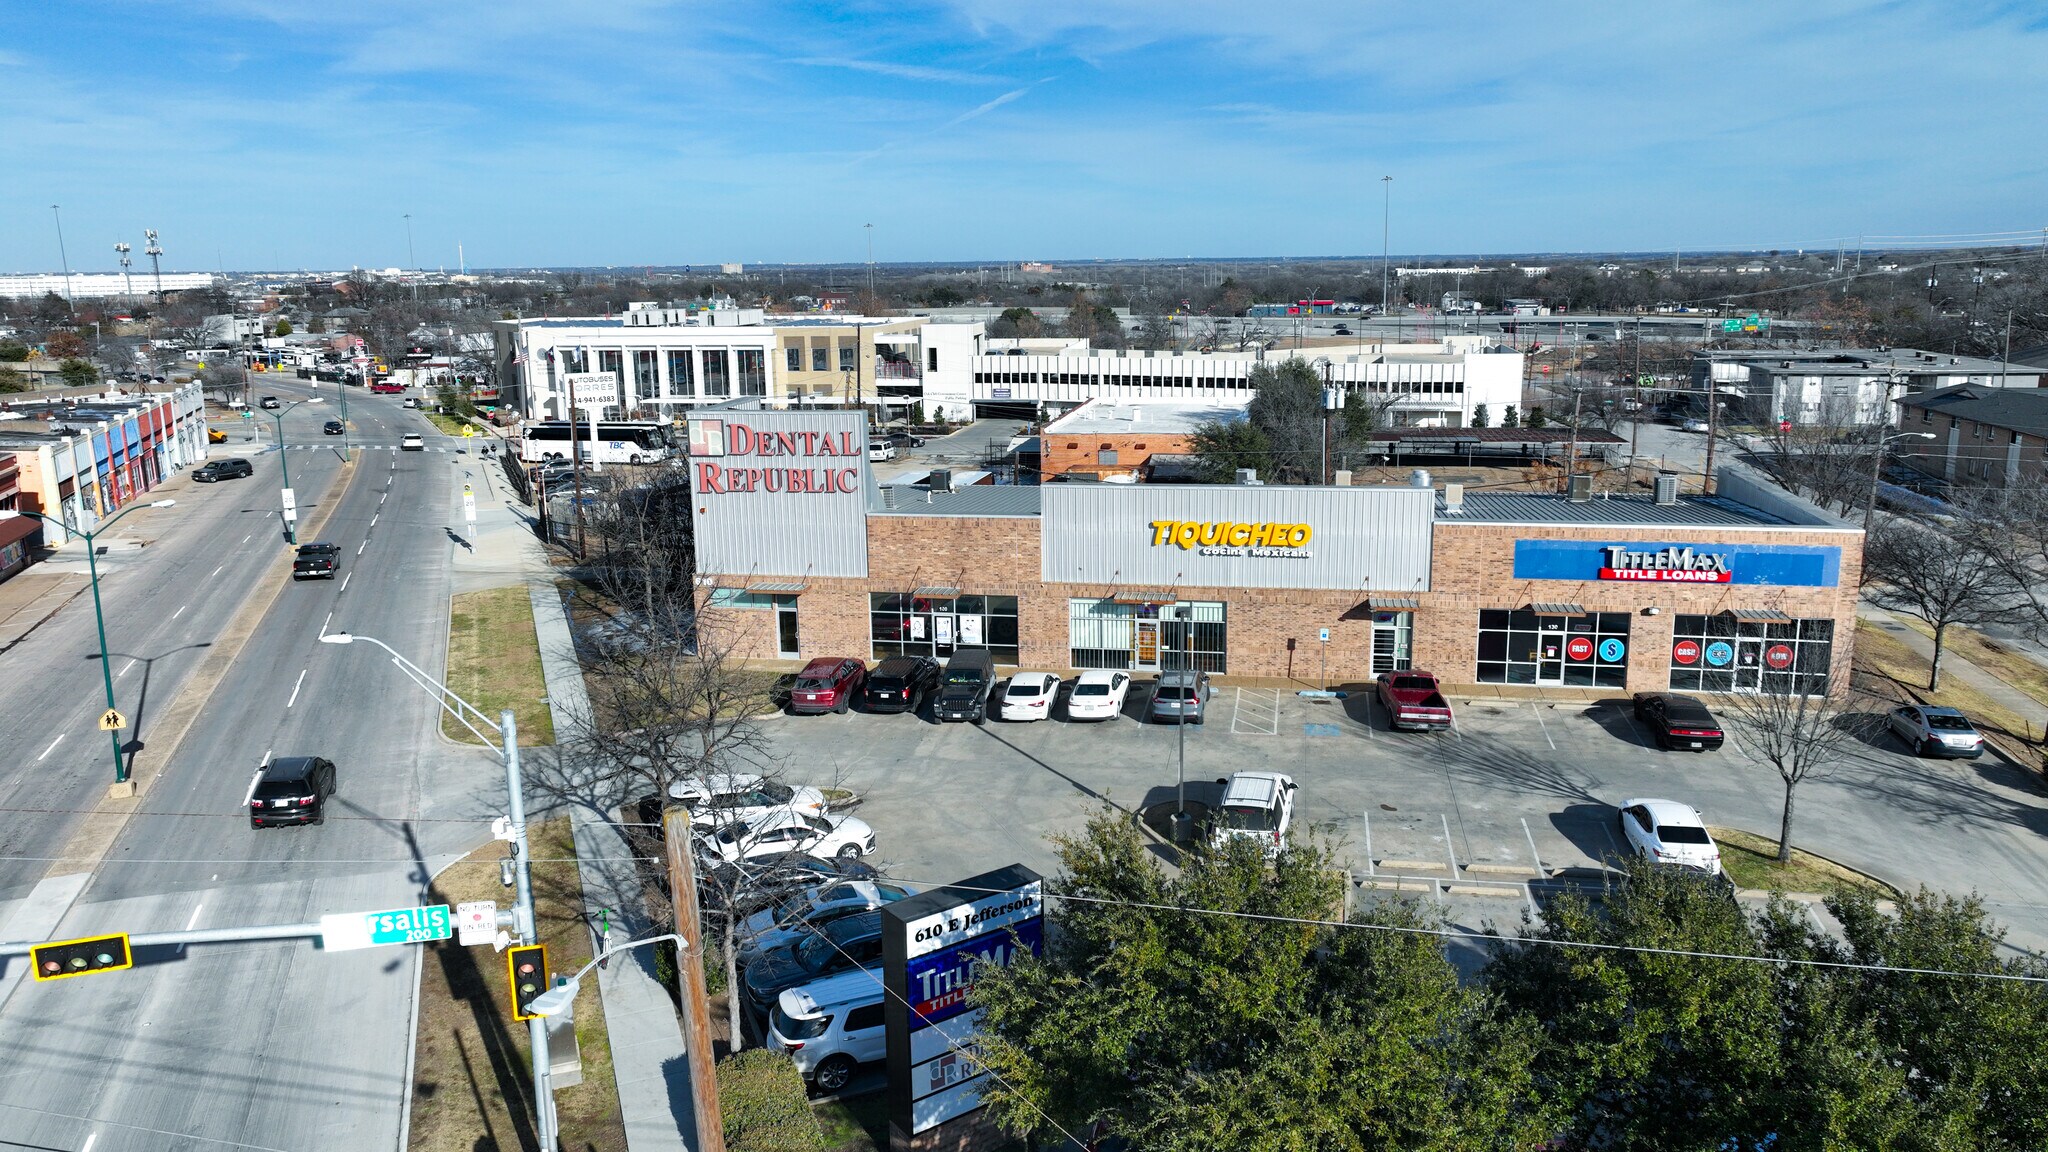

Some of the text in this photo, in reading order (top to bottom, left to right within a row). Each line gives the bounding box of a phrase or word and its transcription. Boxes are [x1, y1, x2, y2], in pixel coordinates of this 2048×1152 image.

[570, 376, 614, 384] UTOBUSES
[571, 383, 615, 391] ORRES
[571, 396, 615, 404] 14-941-6383
[609, 441, 625, 449] TBC
[726, 423, 862, 457] DENTAL
[695, 462, 859, 494] REPUBLIC
[1150, 520, 1313, 550] TIQUICHEO
[1613, 569, 1719, 581] TITLE LOANS
[1571, 644, 1588, 653] FAST
[915, 896, 1034, 943] 610 E Jefferson
[406, 928, 432, 942] 200
